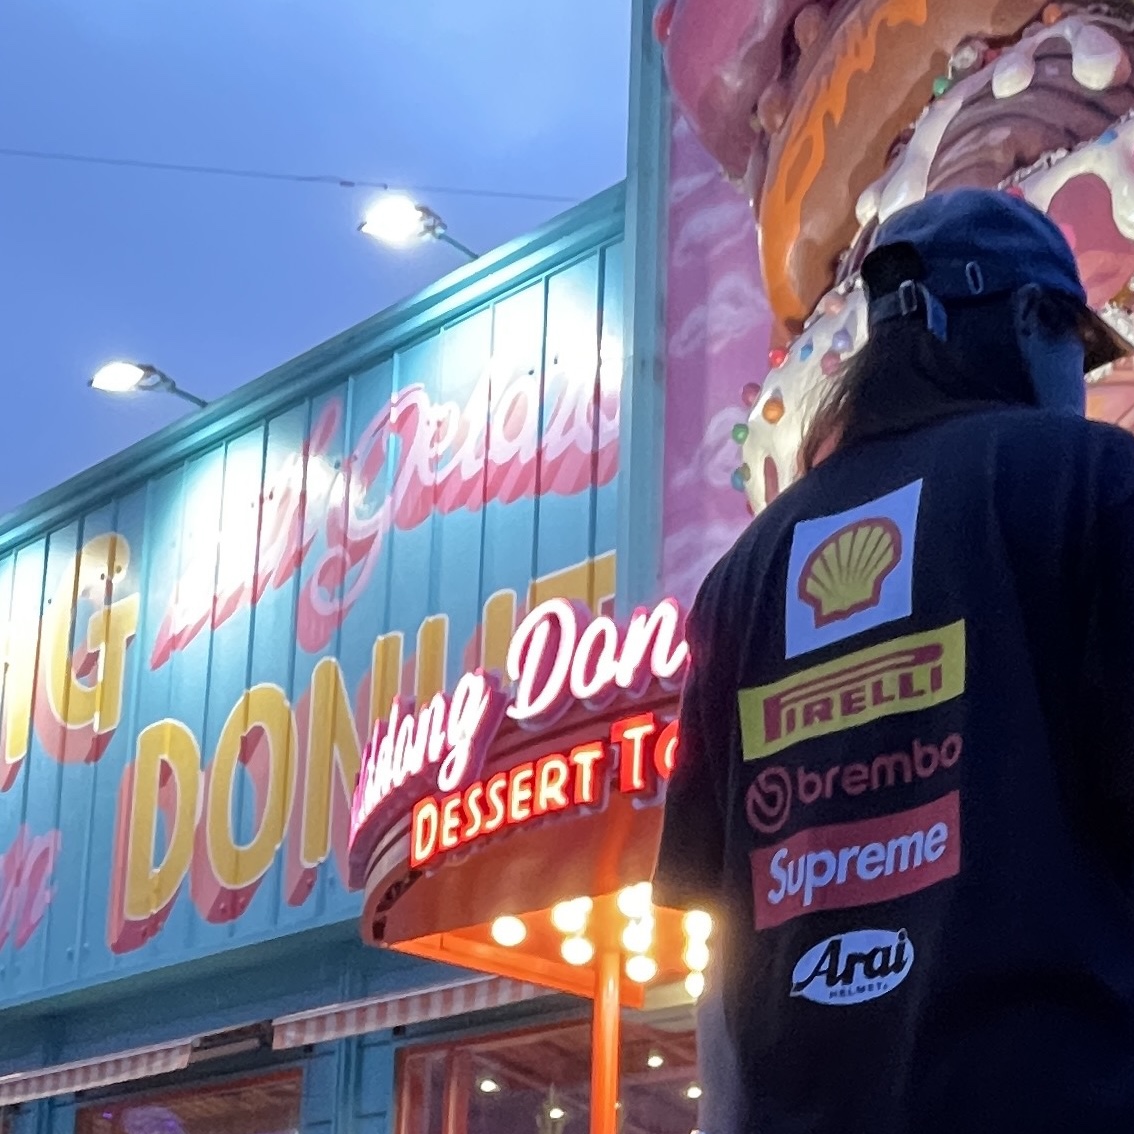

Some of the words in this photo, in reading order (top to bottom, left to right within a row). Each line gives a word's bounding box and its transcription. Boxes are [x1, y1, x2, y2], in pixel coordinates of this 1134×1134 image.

[763, 642, 944, 743] PIRELLI
[411, 740, 605, 868] DESSERT
[797, 732, 963, 804] brembo
[768, 822, 949, 907] Supreme
[791, 929, 909, 988] Arai
